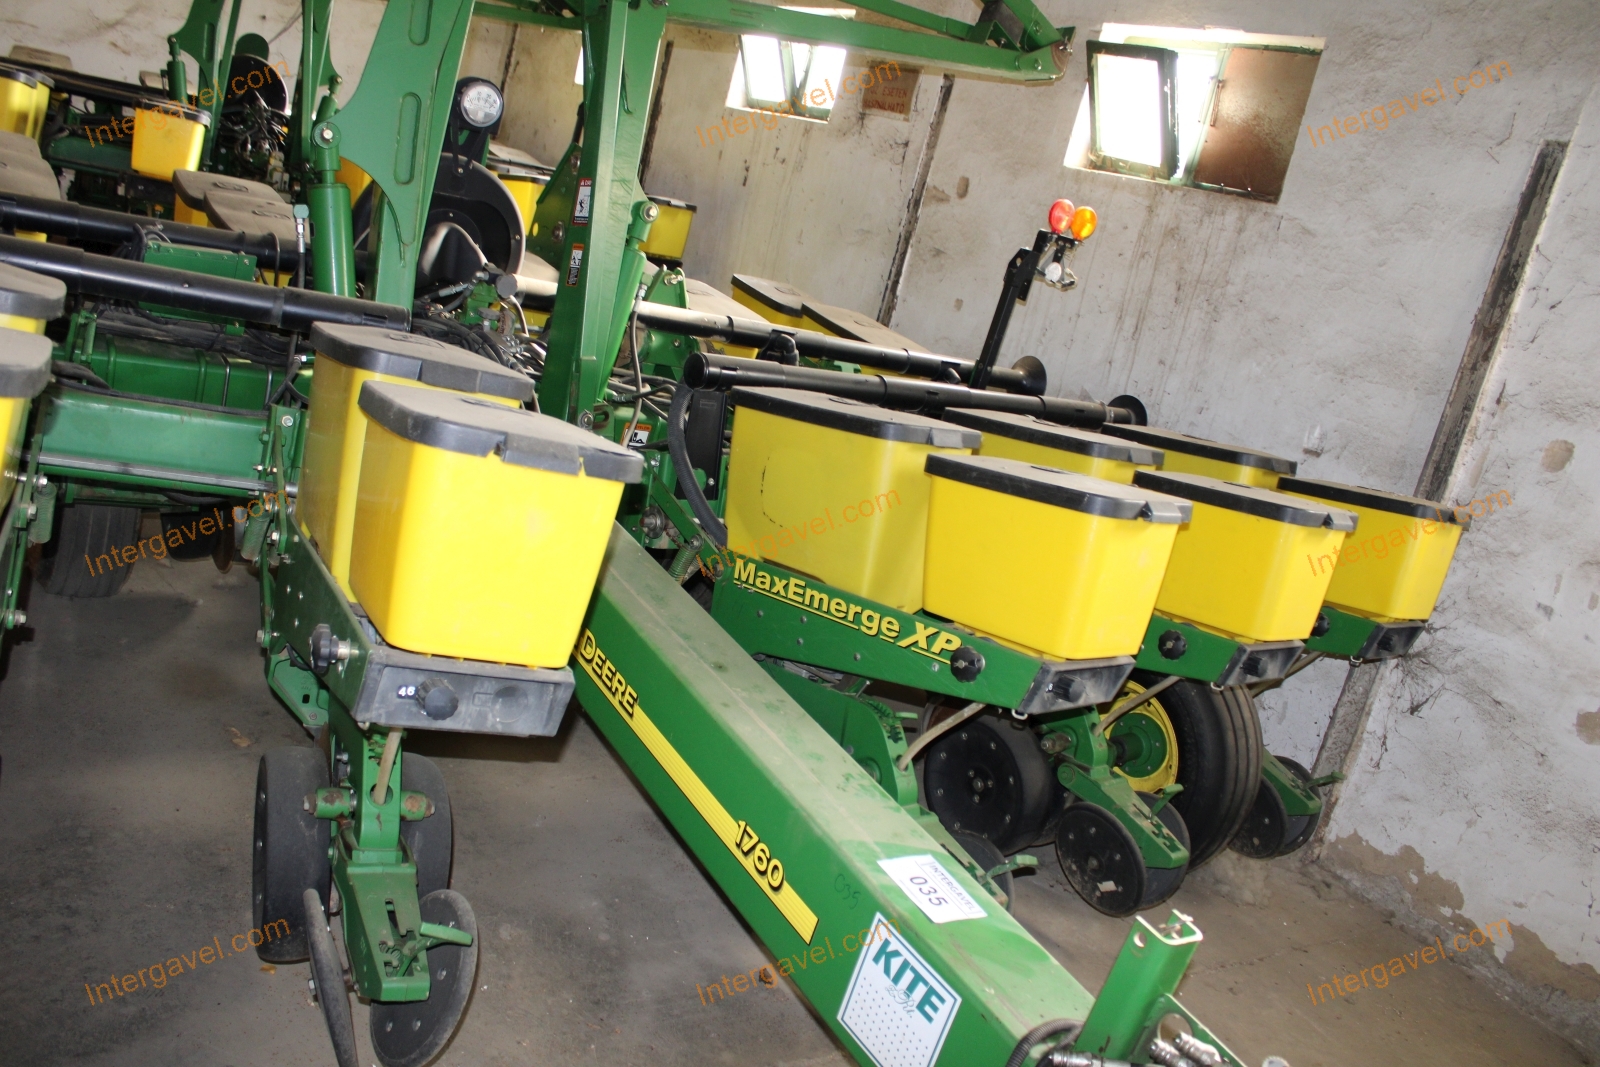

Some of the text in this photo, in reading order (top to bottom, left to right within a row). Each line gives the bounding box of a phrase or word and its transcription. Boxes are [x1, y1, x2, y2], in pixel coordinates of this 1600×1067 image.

[734, 558, 962, 655] MaxEmerge XP
[398, 685, 416, 697] 46
[579, 628, 639, 717] DEERE
[735, 819, 784, 889] 1760
[929, 864, 977, 911] INTERGAVEL
[909, 876, 949, 907] 035
[872, 938, 947, 1024] KITE
